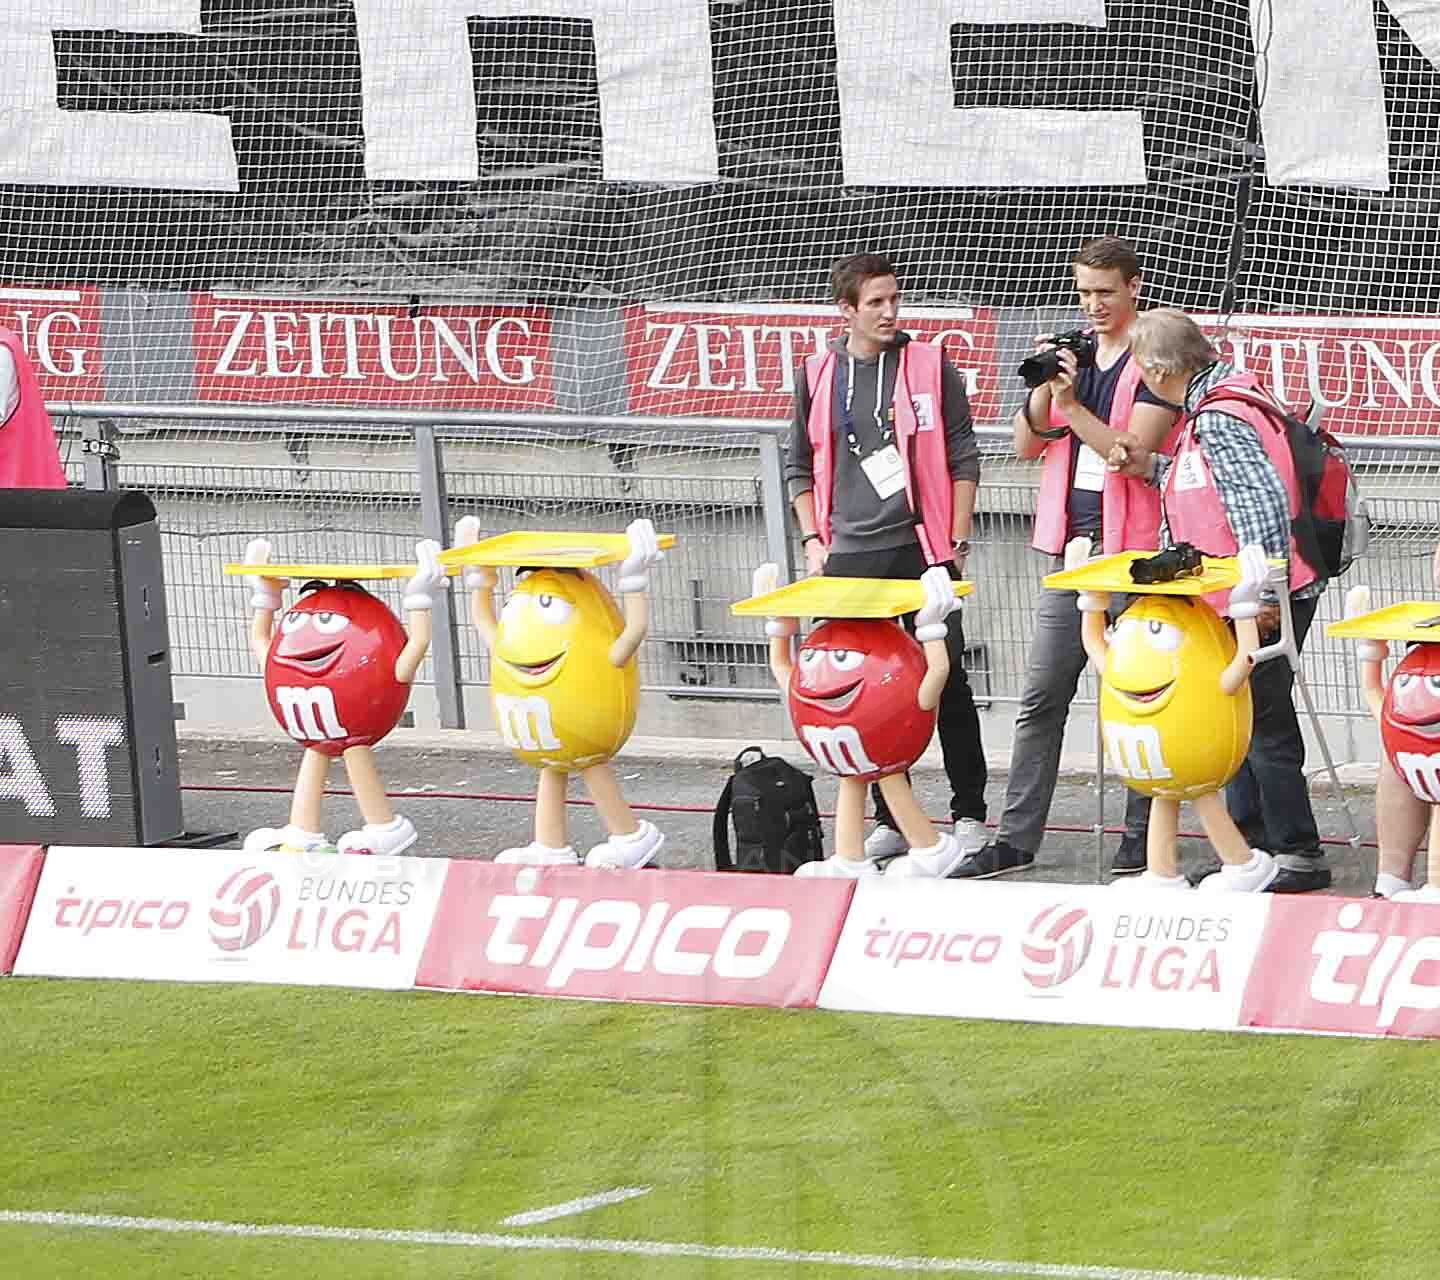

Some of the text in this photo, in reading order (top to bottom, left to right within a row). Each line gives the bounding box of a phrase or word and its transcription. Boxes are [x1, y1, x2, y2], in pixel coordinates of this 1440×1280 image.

[212, 308, 541, 386] ZEITUNG
[276, 685, 348, 740] m
[496, 693, 560, 751] m
[801, 725, 879, 775] m
[1103, 721, 1172, 780] m
[55, 886, 191, 937] tipico
[299, 877, 414, 907] BUNDES
[287, 910, 401, 957] LIGA
[487, 867, 792, 989] tipico
[864, 917, 1001, 968] tipico
[1112, 914, 1232, 943] BUNDES
[1101, 946, 1221, 993] LIGA
